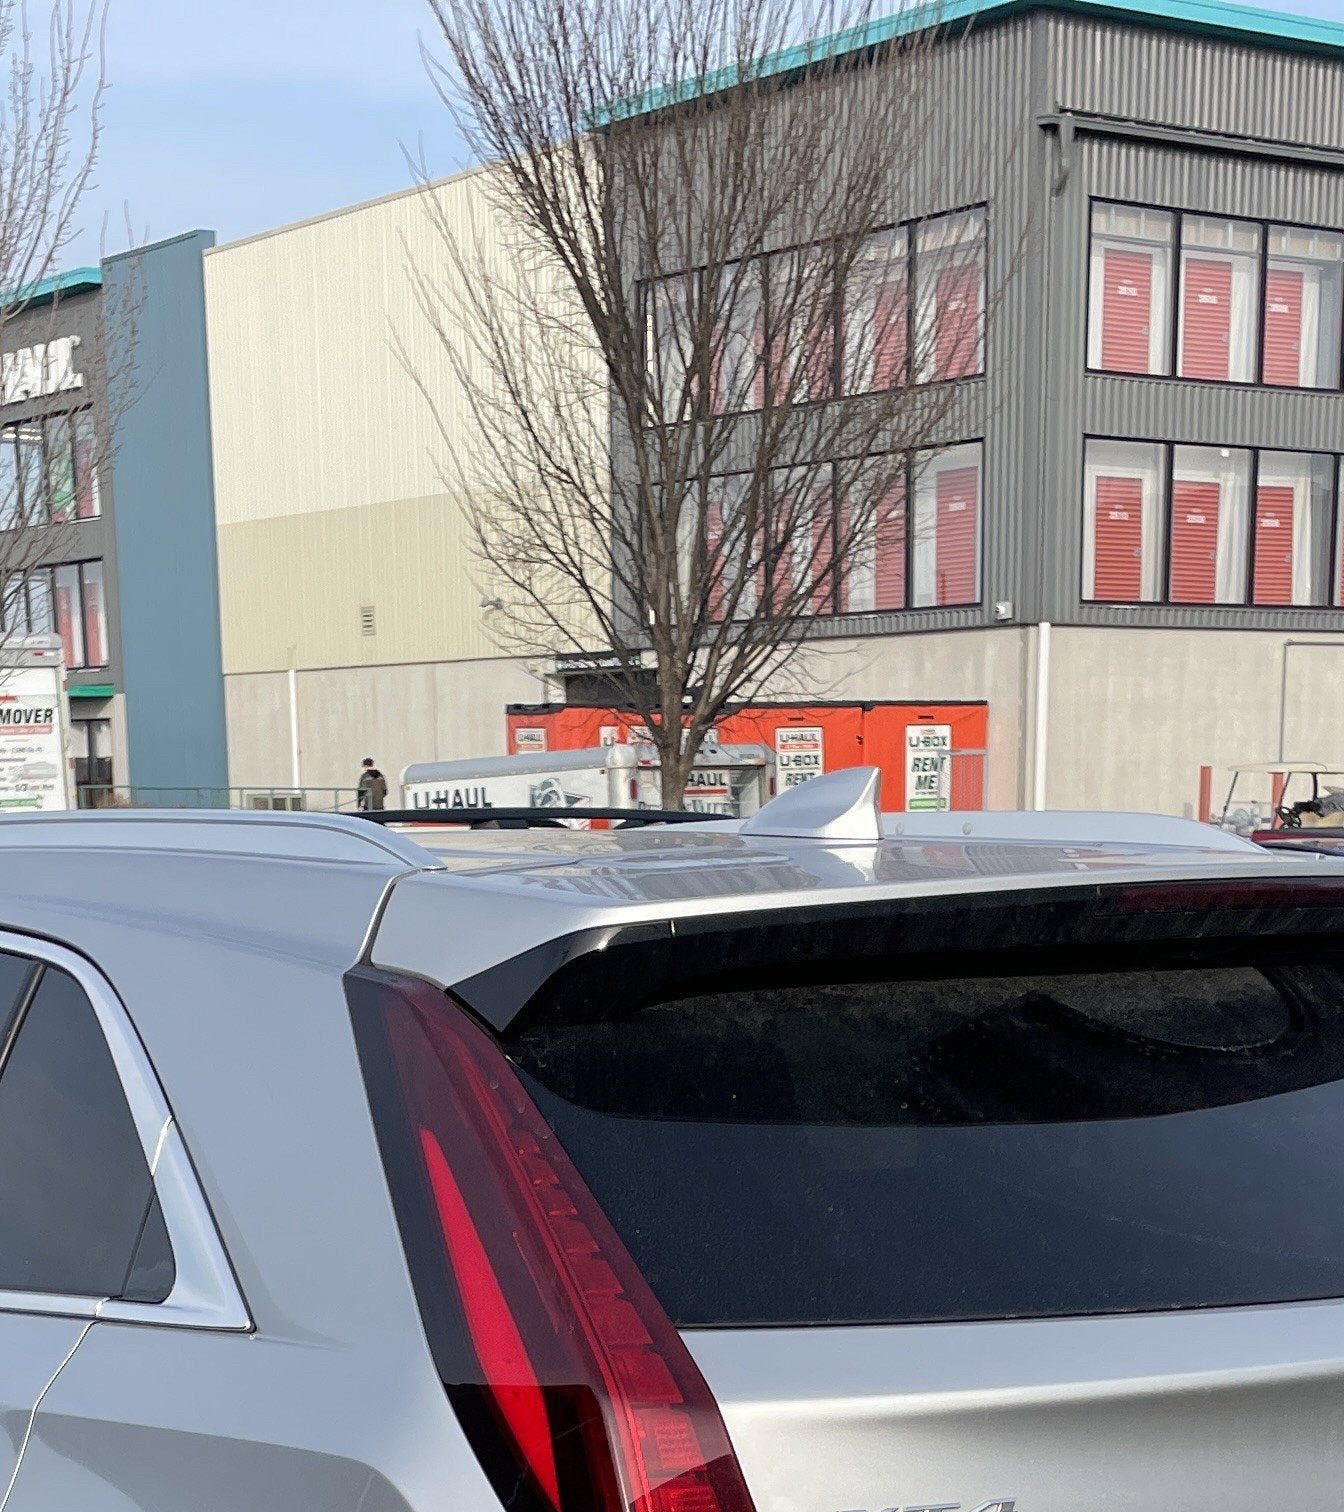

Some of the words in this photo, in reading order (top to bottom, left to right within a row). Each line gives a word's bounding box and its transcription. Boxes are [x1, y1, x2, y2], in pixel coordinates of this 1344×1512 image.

[908, 735, 947, 748] U-BOX
[779, 754, 820, 767] U-BOX
[911, 756, 947, 773] RENT
[687, 773, 727, 787] HAUL
[915, 775, 938, 790] ME
[413, 787, 493, 809] U-HAUL
